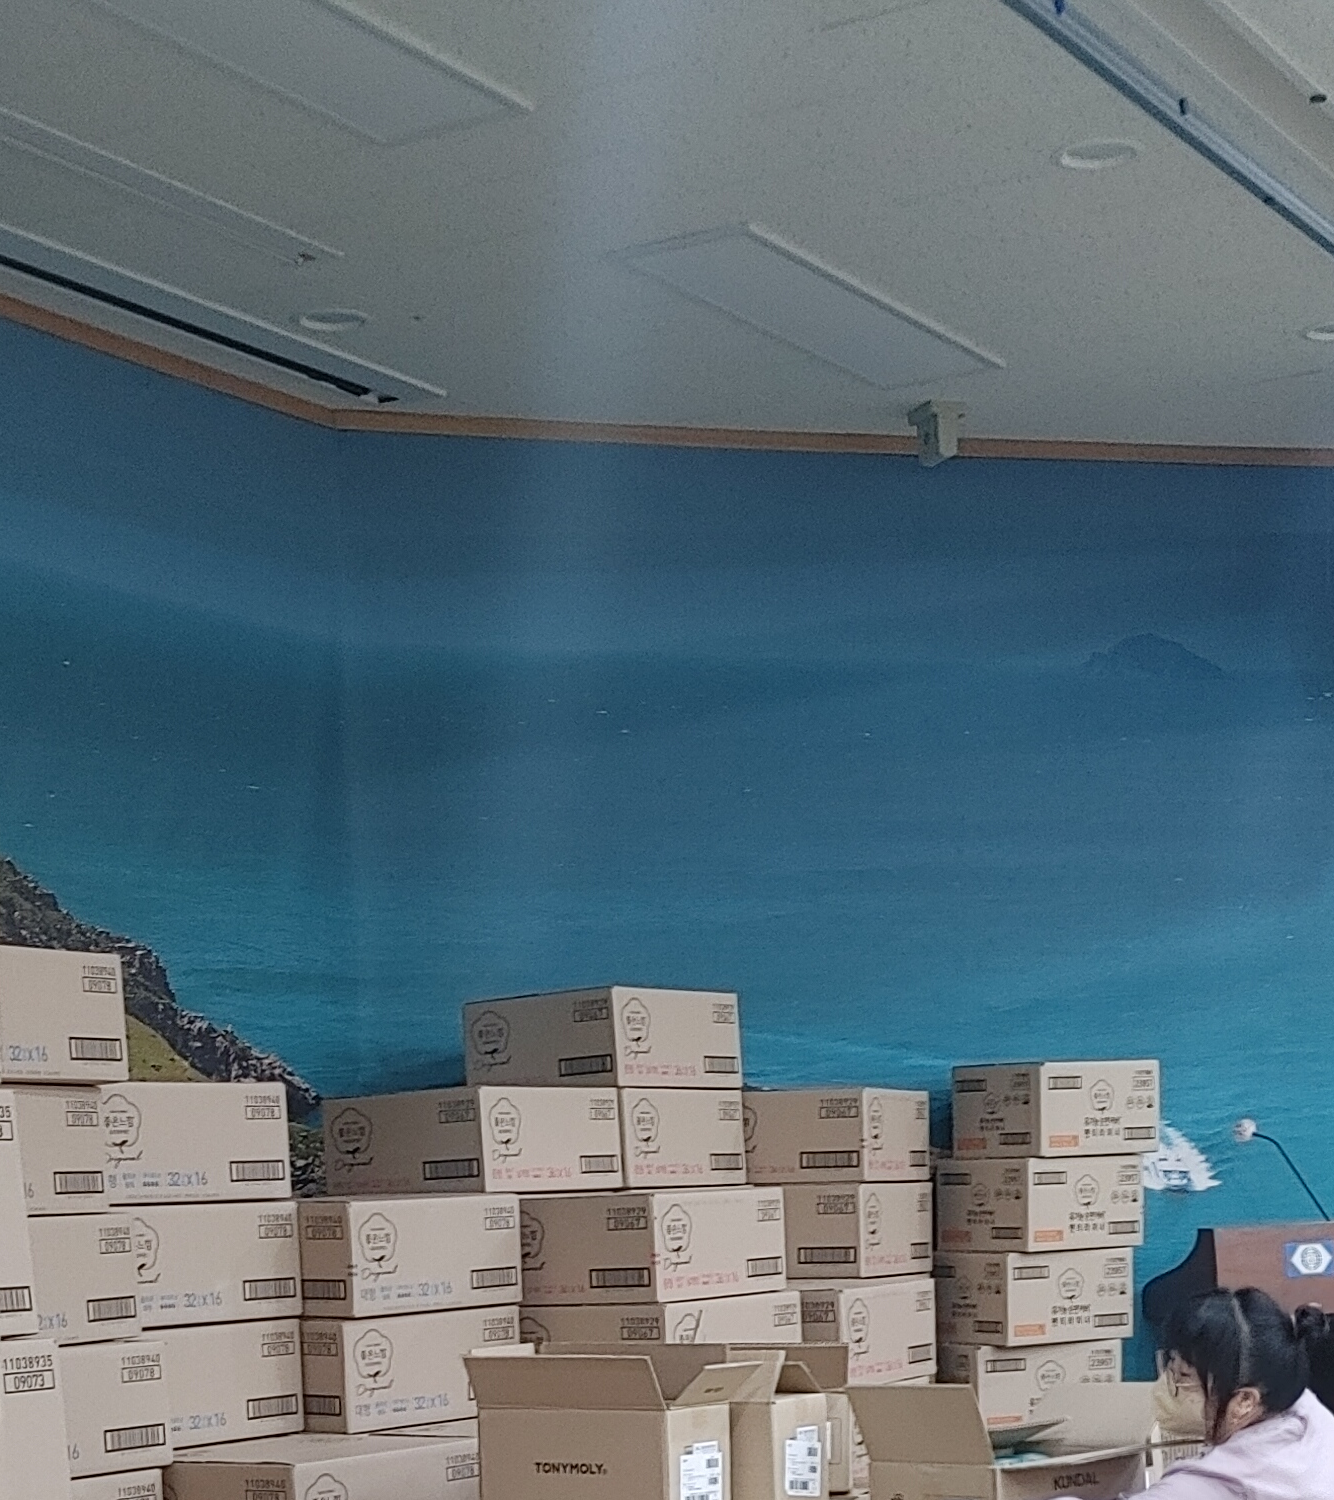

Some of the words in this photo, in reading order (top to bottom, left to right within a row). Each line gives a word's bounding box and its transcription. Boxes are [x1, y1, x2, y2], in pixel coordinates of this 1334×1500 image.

[2, 1355, 53, 1371] 11038935
[13, 1375, 45, 1389] 09073
[533, 1461, 604, 1475] TONYMOLY
[1053, 1471, 1100, 1492] KUNDAL
